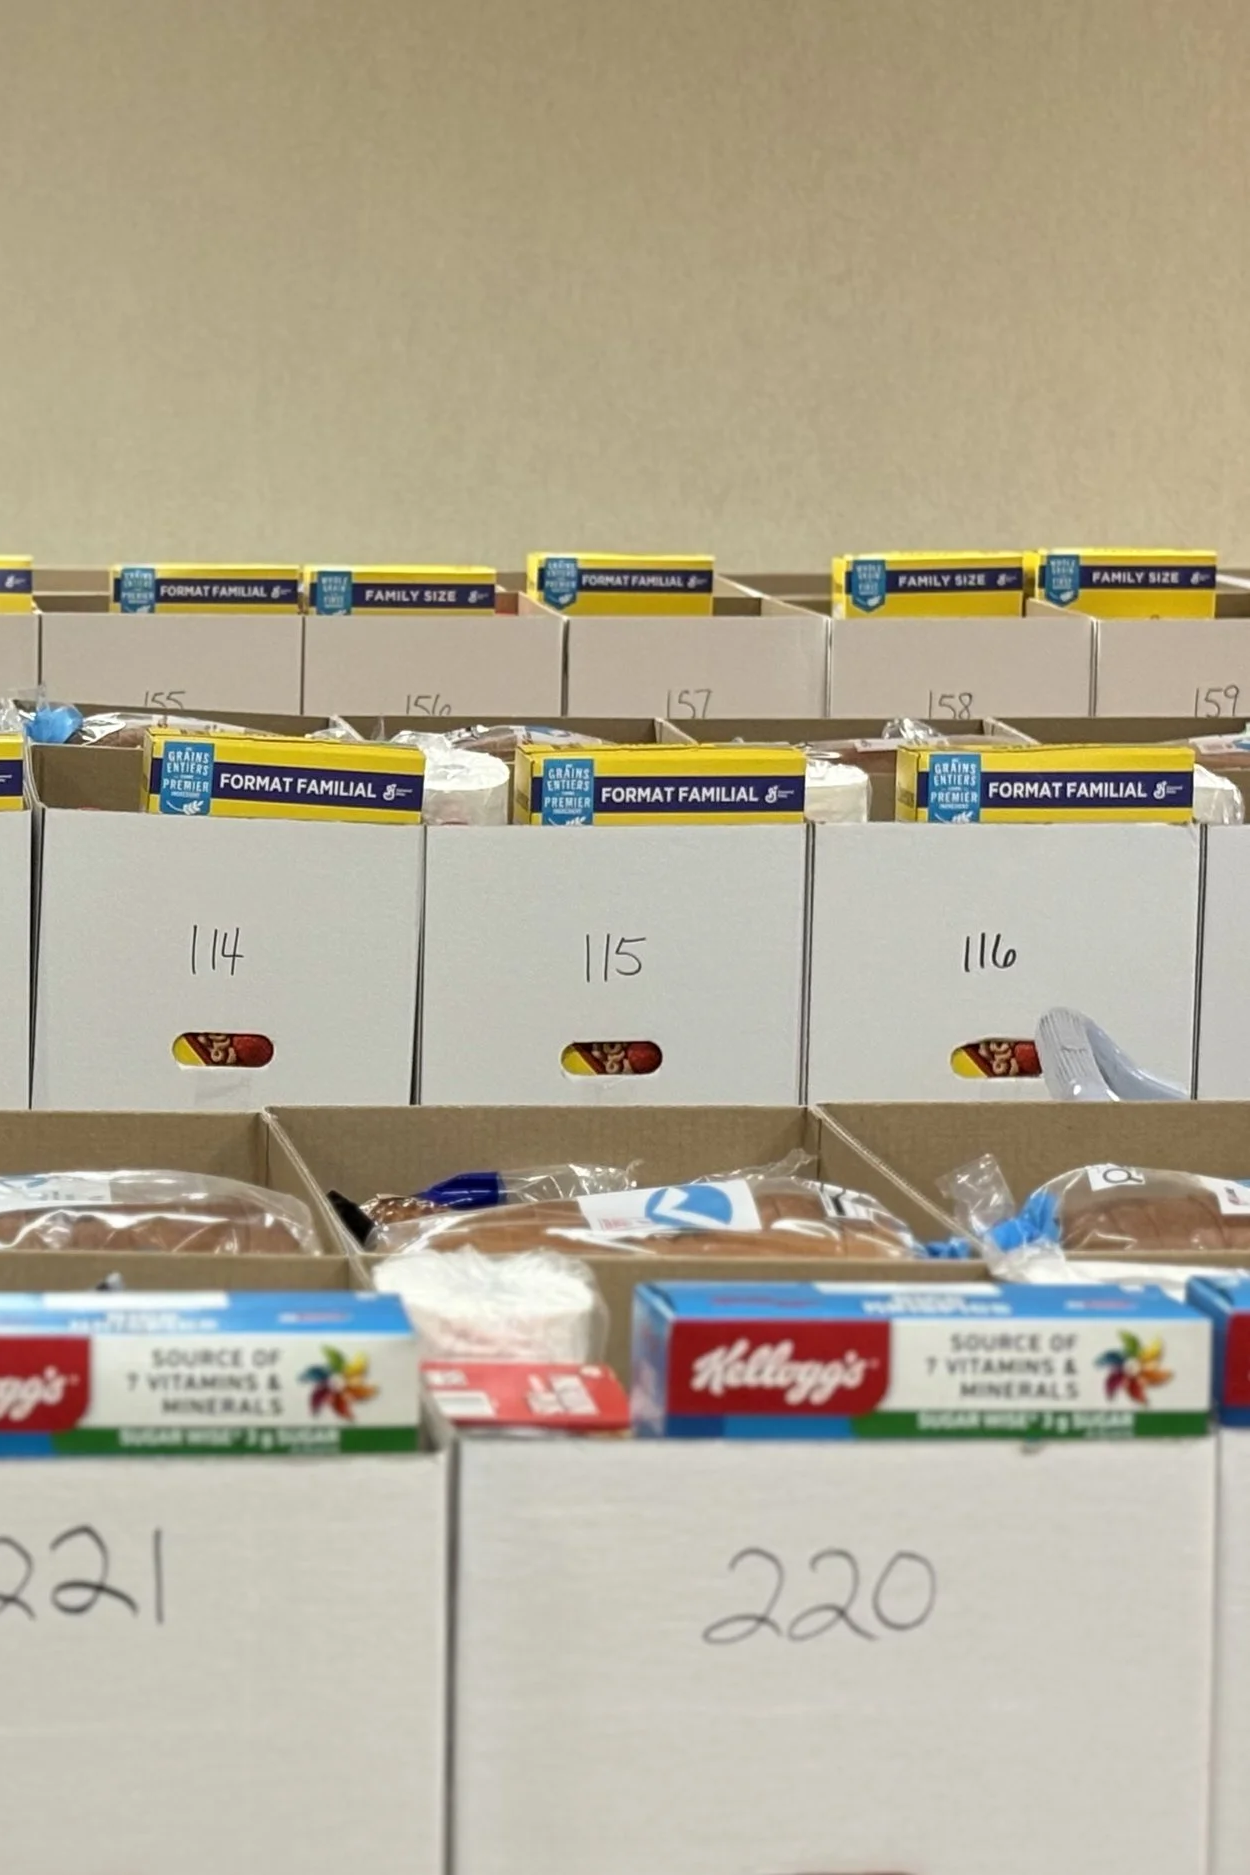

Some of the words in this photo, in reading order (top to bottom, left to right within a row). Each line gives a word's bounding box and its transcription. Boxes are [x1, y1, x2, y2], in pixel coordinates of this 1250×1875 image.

[582, 574, 629, 586] FORMAT
[632, 575, 683, 588] FAMILIAL
[898, 575, 950, 587] FAMILY
[955, 574, 986, 586] SIZE
[1092, 572, 1144, 584] FAMILY
[1149, 572, 1179, 584] SIZE
[160, 585, 211, 597] FORMAT
[212, 586, 267, 598] FAMILIAL
[365, 590, 419, 602] FAMILY
[424, 590, 456, 602] SIZE
[666, 689, 712, 719] 157
[928, 690, 973, 719] 158
[1194, 684, 1240, 718] 159
[168, 751, 210, 764] GRAINS
[166, 763, 209, 776] ENTIERS
[548, 767, 590, 779] GRAINS
[934, 763, 976, 775] GRAINS
[163, 778, 209, 793] PREMIER
[220, 773, 292, 793] FORMAT
[296, 778, 377, 799] FAMILIAL
[547, 779, 590, 791] ENTIERS
[934, 775, 976, 787] ENTIERS
[601, 787, 675, 803] FORMAT
[678, 786, 758, 803] FAMILIAL
[931, 792, 978, 803] PREMIER
[988, 782, 1062, 799] FORMAT
[1065, 782, 1147, 799] FAMILIAL
[544, 797, 590, 808] PREMIER
[191, 925, 245, 975] 114
[585, 933, 647, 982] 115
[964, 932, 1017, 972] 116
[949, 1334, 1041, 1352] SOURCE
[1050, 1334, 1079, 1352] OF
[152, 1348, 244, 1369] SOURCE
[253, 1349, 282, 1369] OF
[926, 1358, 938, 1375] 7
[947, 1357, 1055, 1376] VITAMINS
[1063, 1357, 1079, 1375] &
[692, 1340, 867, 1404] Kellogg's
[126, 1375, 139, 1392] 7
[149, 1373, 259, 1392] VITAMINS
[266, 1374, 282, 1392] &
[959, 1381, 1080, 1400] MINERALS
[161, 1397, 284, 1418] MINERALS
[700, 1546, 937, 1646] 220
